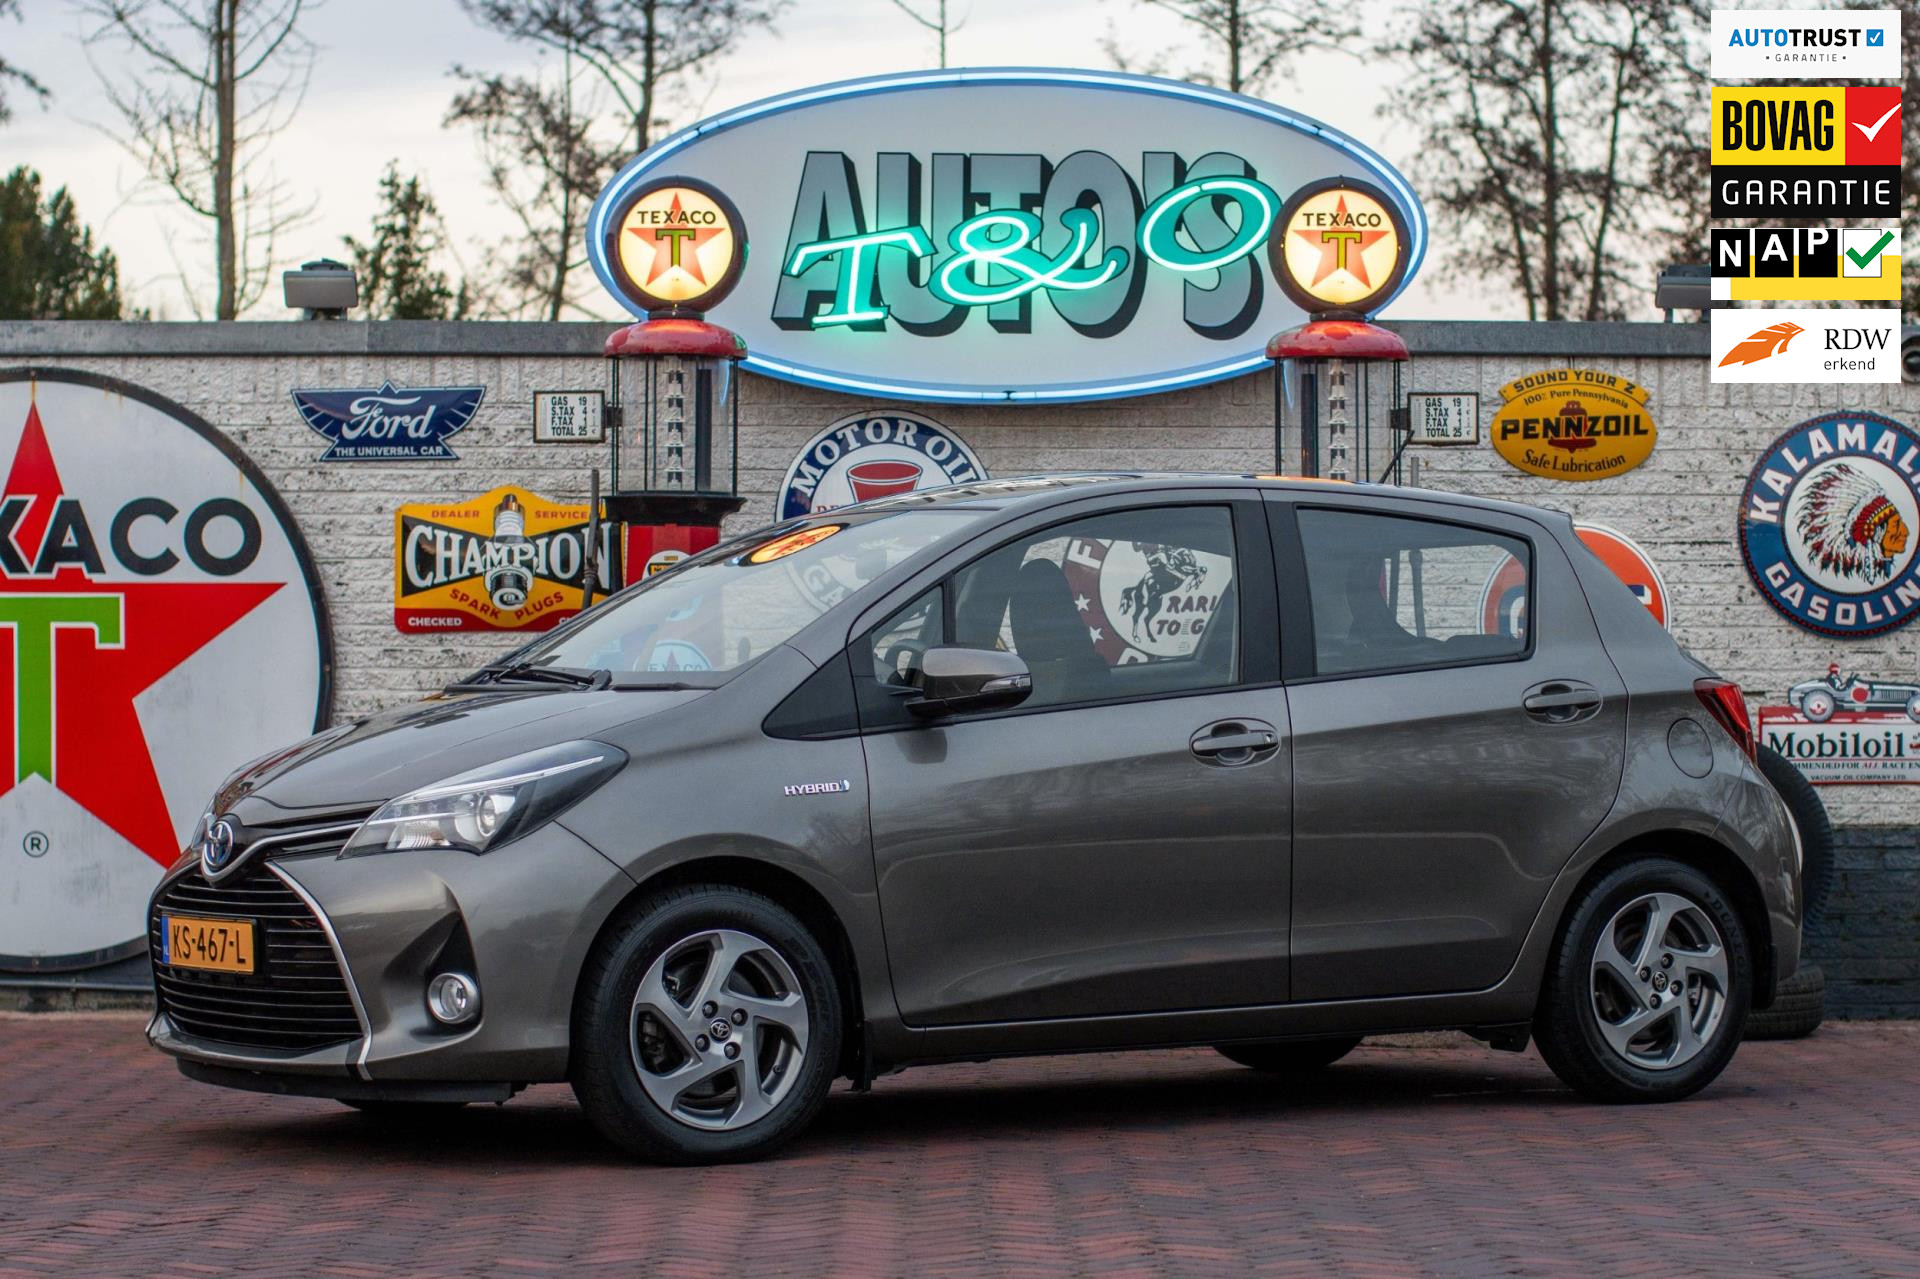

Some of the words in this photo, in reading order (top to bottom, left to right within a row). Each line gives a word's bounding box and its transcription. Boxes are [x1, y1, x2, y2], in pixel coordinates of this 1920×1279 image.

[637, 211, 716, 224] TEXACO
[1303, 213, 1381, 227] TEXACO
[655, 228, 696, 267] T
[1322, 231, 1362, 269] T
[1513, 371, 1568, 393] SOUND
[1574, 370, 1617, 387] YOUR
[551, 396, 568, 406] GAS
[1425, 398, 1442, 407] GAS
[1550, 389, 1571, 399] Pure
[1573, 389, 1628, 409] Pennsylvania
[341, 396, 437, 441] Ford
[1501, 414, 1649, 441] PENNZOIL
[551, 427, 575, 436] TOTAL
[578, 427, 588, 436] 25
[1425, 428, 1450, 437] TOTAL
[1453, 428, 1462, 437] 25
[335, 447, 356, 457] THE
[358, 446, 418, 457] UNIVERSAL
[420, 446, 443, 456] CAR
[789, 418, 919, 498] MOTOR
[1522, 449, 1550, 470] Safe
[1552, 453, 1626, 472] Lubrication
[1750, 423, 1920, 523] KALAMAL
[431, 509, 480, 519] DEALER
[535, 510, 588, 519] SERVICE
[405, 521, 613, 589] CHAMPION
[1765, 561, 1920, 626] GASOLIN
[450, 588, 500, 620] SPARK
[515, 591, 564, 621] PLUGS
[408, 617, 463, 627] CHECKED
[1157, 619, 1181, 636] TO
[1768, 731, 1904, 758] Mobiloil
[784, 782, 840, 796] HYBRID
[173, 923, 246, 965] KS-467-L
